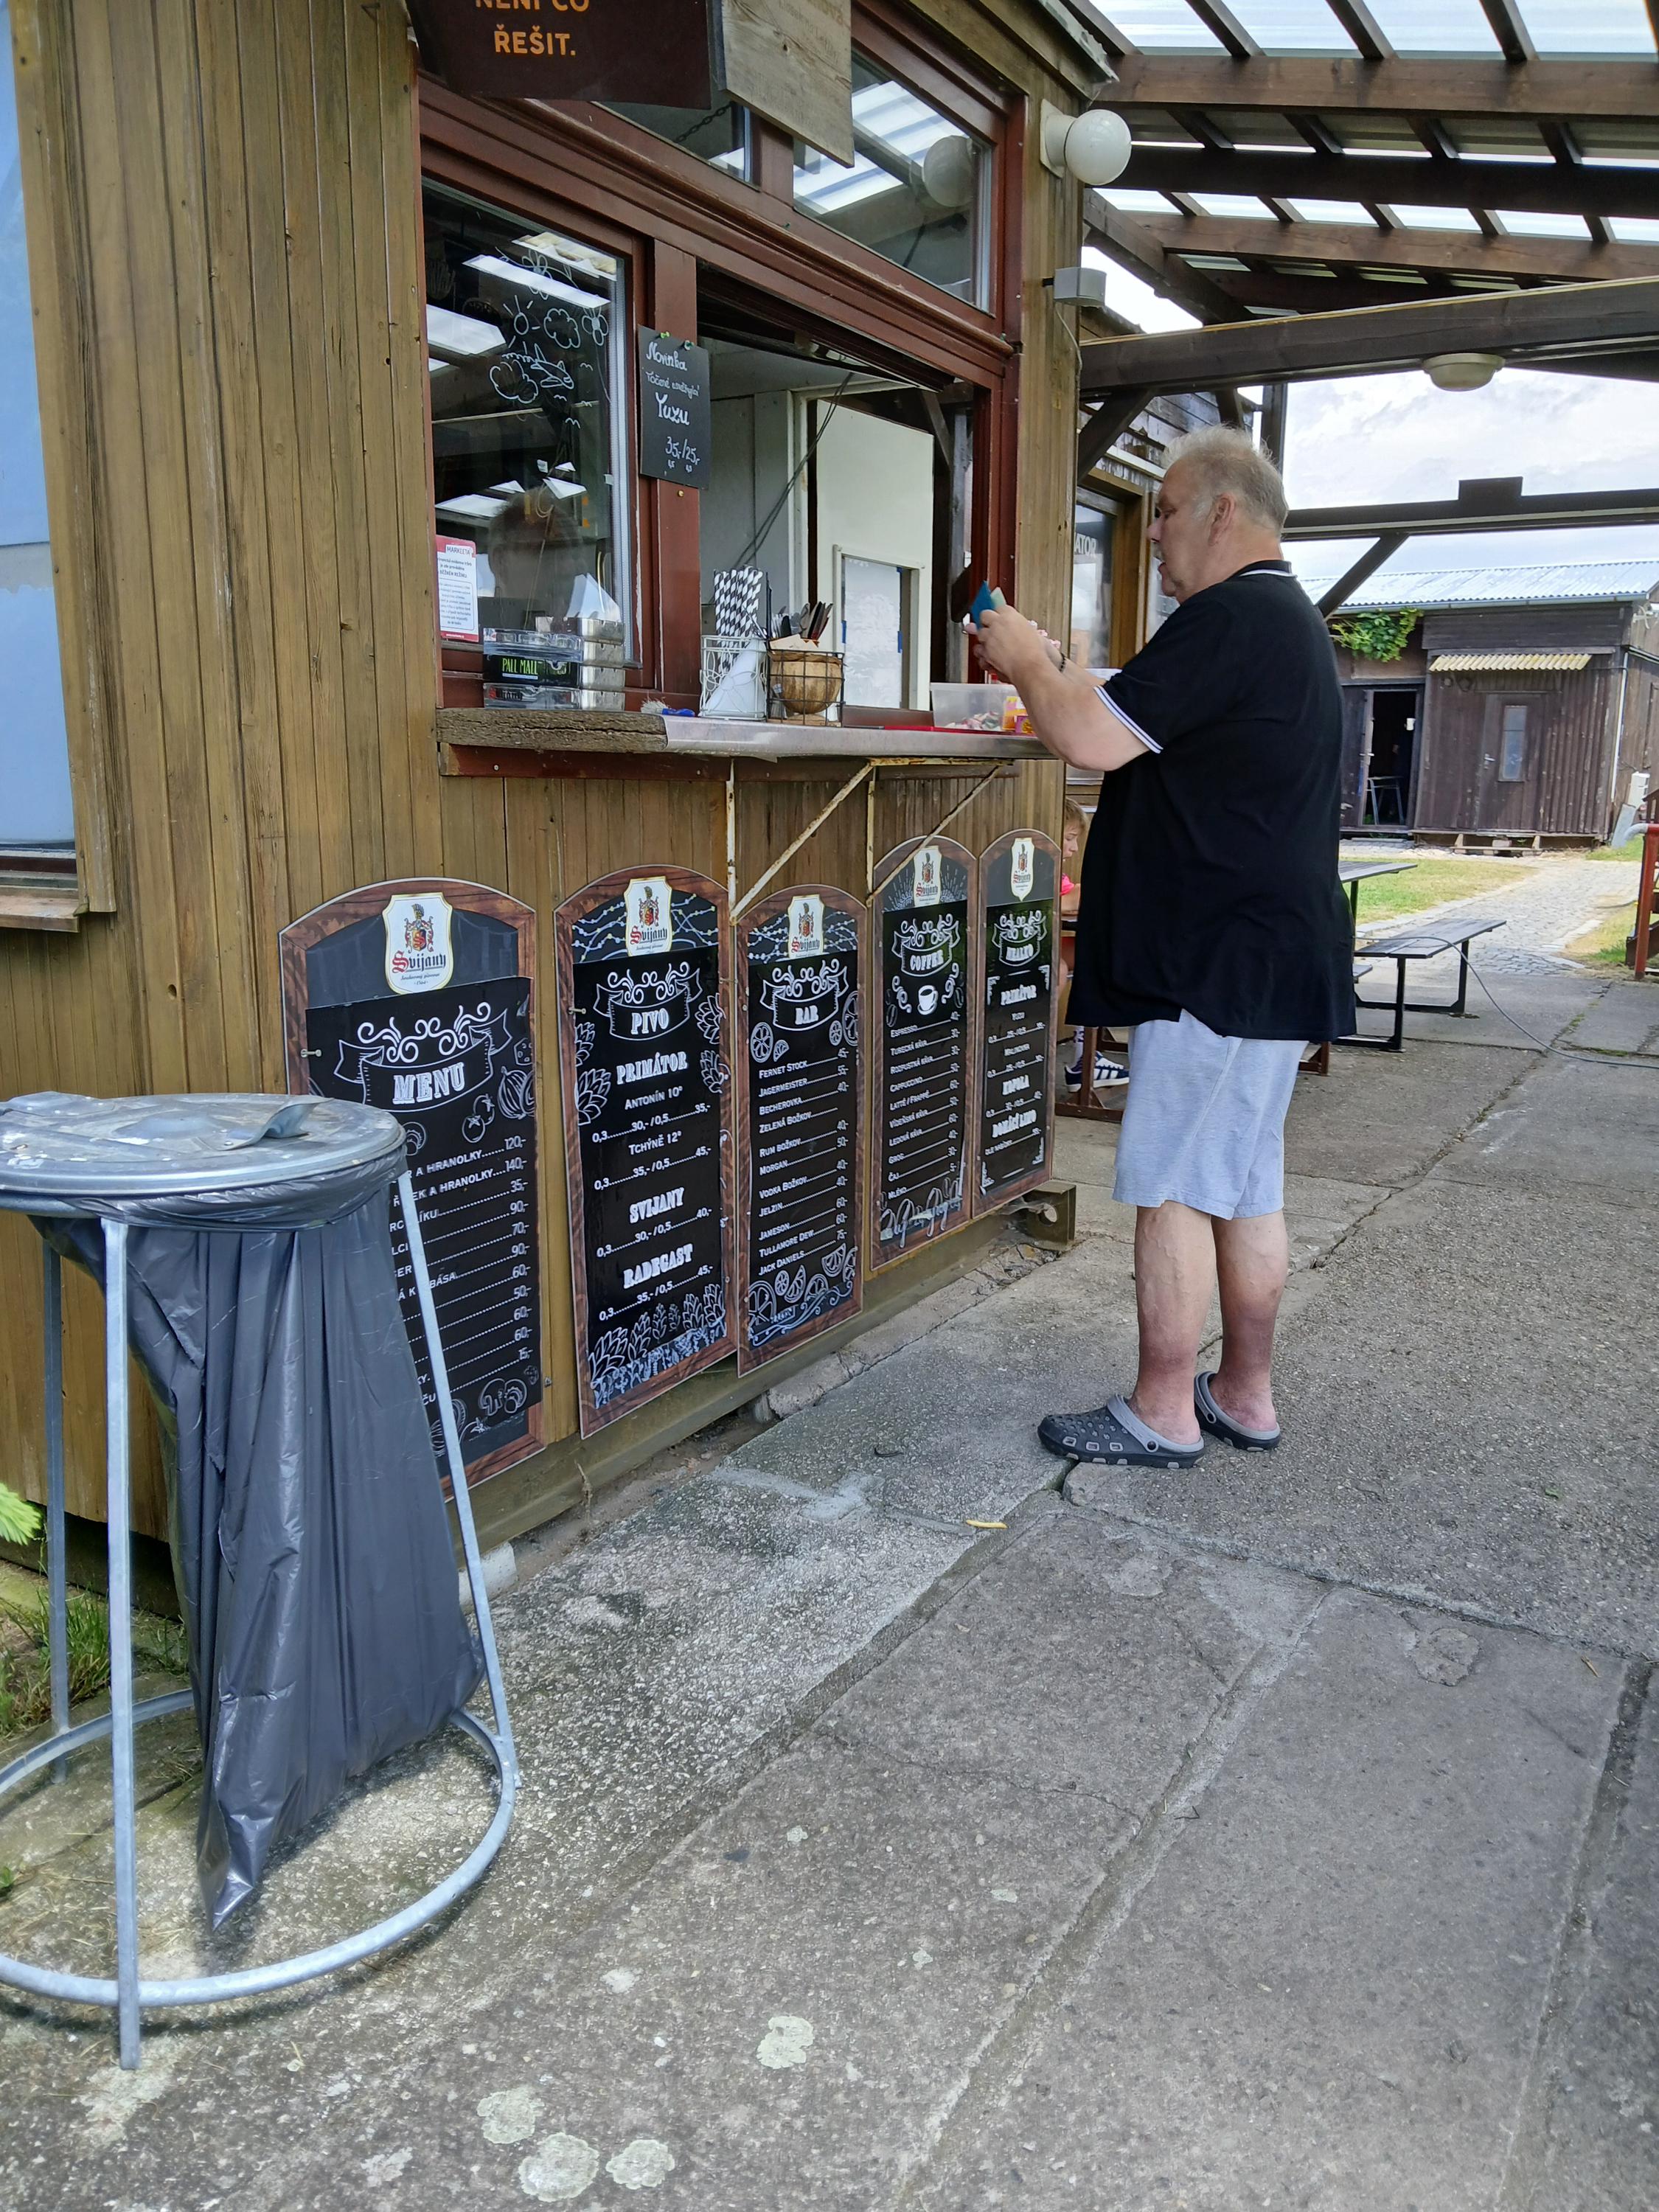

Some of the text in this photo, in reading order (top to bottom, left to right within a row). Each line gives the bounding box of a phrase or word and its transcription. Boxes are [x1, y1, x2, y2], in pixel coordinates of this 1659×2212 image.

[494, 24, 576, 55] ŘEŠIT.
[646, 341, 687, 371] Novinka
[655, 392, 689, 425] Yuzu
[1074, 532, 1098, 558] ATOR
[502, 658, 538, 675] PALL MALL
[630, 925, 667, 945] Svijany
[791, 936, 820, 953] Svijany
[392, 950, 446, 973] Svijany
[910, 949, 944, 971] COFFEE
[630, 1008, 669, 1034] PIVO
[795, 1005, 818, 1025] BAR
[616, 1051, 687, 1085] PRIMÁTOR
[759, 1065, 786, 1079] FERNET
[787, 1060, 807, 1071] STOCK
[392, 1062, 465, 1105] MENU
[625, 1090, 665, 1110] ANTONÍN
[759, 1097, 803, 1116] BECHEROVKA
[759, 1111, 812, 1133] ZELENÁ BOŽKOV
[592, 1130, 608, 1143] 0,3
[628, 1134, 664, 1155] TCHÝNĚ
[759, 1147, 776, 1158] RUM
[776, 1138, 801, 1152] BOŽKOV
[416, 1170, 424, 1178] A
[426, 1150, 482, 1173] HRANOLKY
[759, 1160, 788, 1175] MORGAN
[428, 1186, 437, 1196] A
[439, 1169, 494, 1193] HRANOLKY
[594, 1178, 609, 1190] 0,3
[759, 1185, 782, 1199] VODKA
[782, 1175, 807, 1191] BOŽKOV
[630, 1187, 685, 1223] SVIJANY
[759, 1202, 783, 1217] JELZIN
[759, 1222, 790, 1241] JAMESON
[597, 1245, 612, 1257] 0,3
[759, 1236, 798, 1258] TULLAMORE
[623, 1243, 693, 1289] RADEGAST
[759, 1262, 775, 1276] JACK
[776, 1250, 804, 1268] DANIELS
[599, 1307, 614, 1321] 0,3
